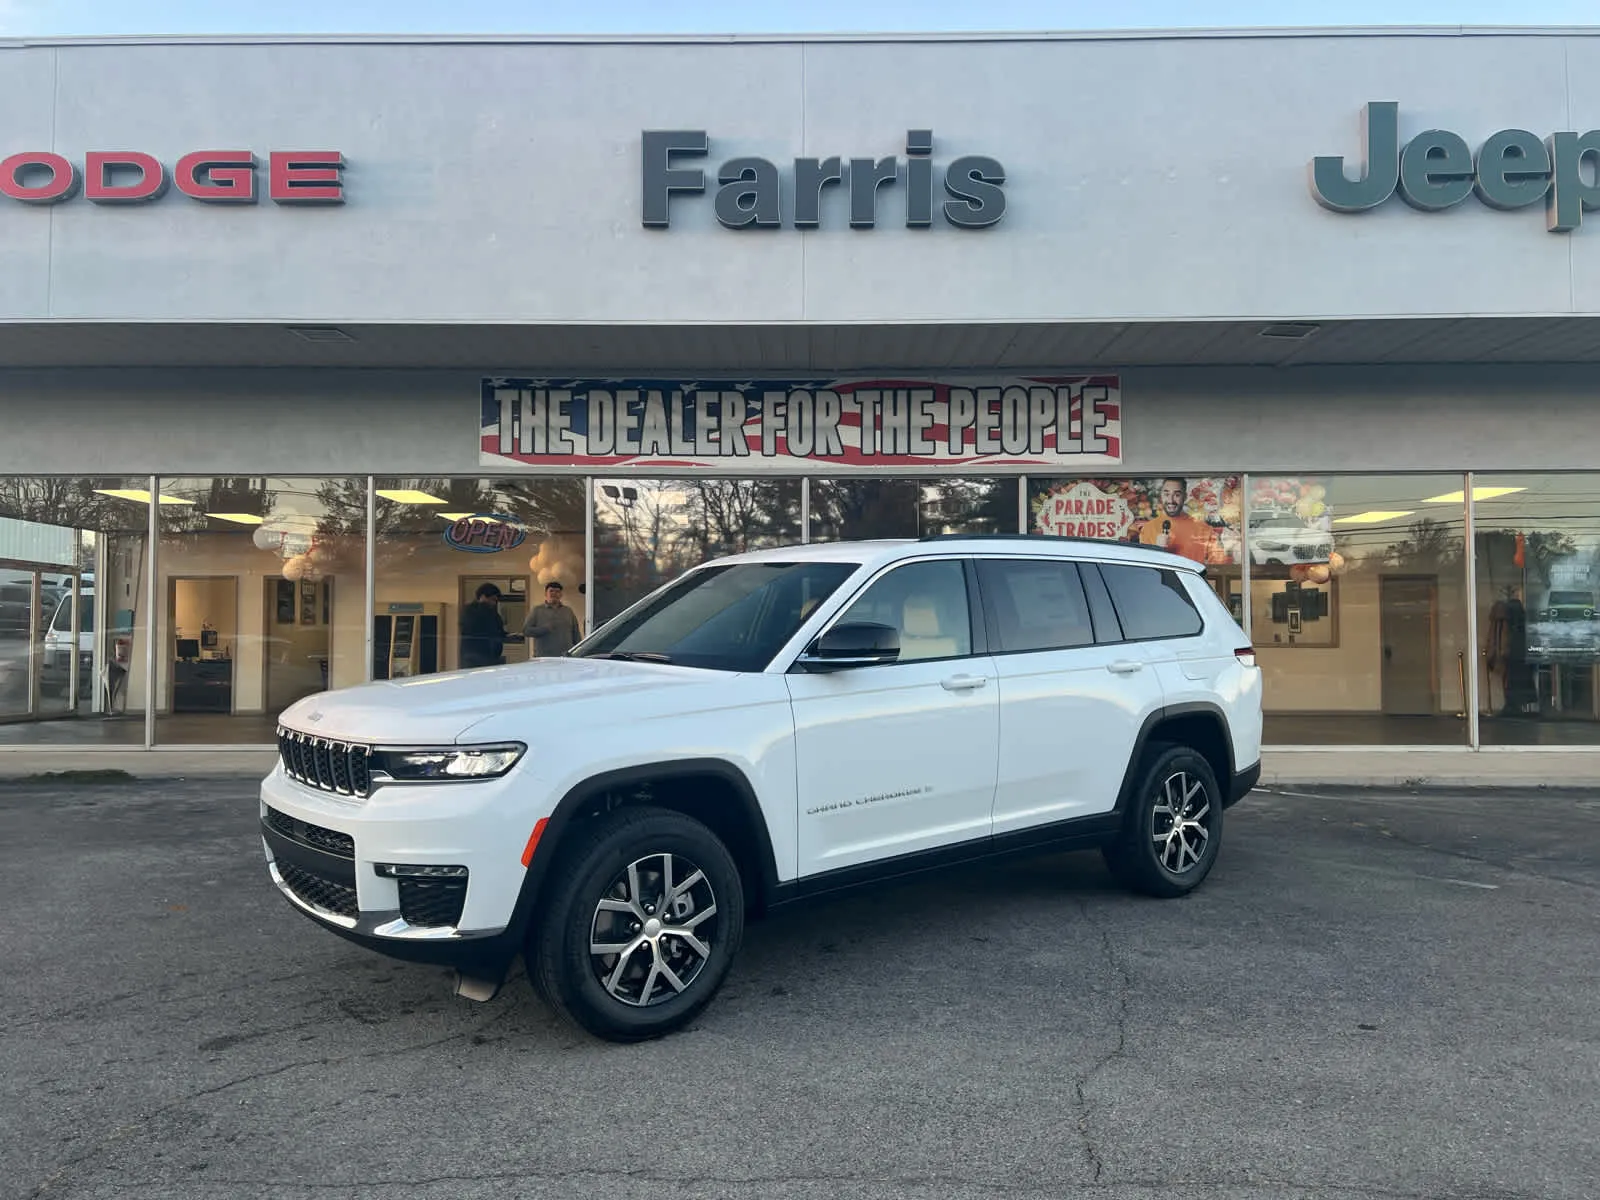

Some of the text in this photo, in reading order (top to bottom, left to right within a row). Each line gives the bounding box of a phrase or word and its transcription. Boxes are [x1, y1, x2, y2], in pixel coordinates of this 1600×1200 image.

[642, 130, 1006, 229] Farris
[1309, 101, 1600, 232] Jeep
[494, 385, 1109, 457] THE DEALER FOR THE PEOPLE
[1054, 521, 1117, 538] TRADES
[1055, 499, 1116, 515] PARADE
[450, 518, 518, 550] OPEN
